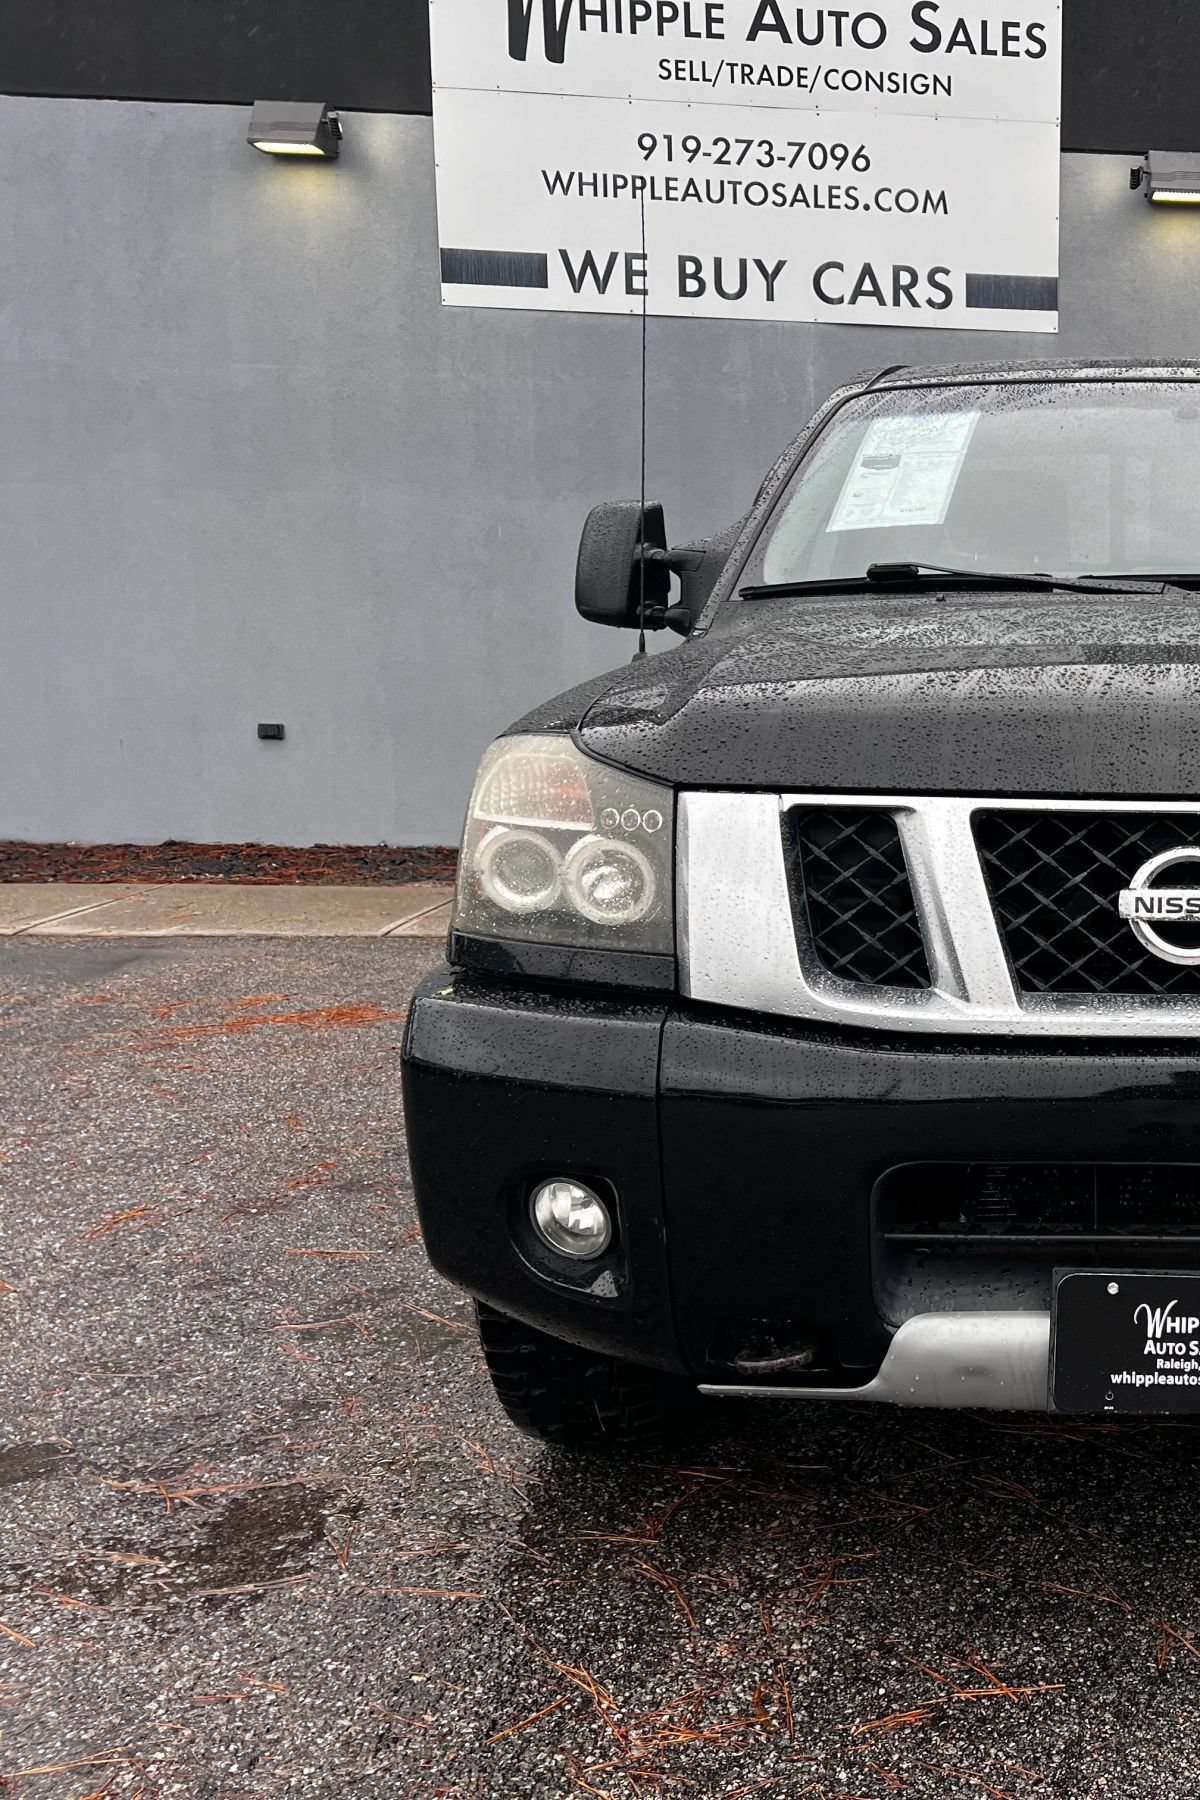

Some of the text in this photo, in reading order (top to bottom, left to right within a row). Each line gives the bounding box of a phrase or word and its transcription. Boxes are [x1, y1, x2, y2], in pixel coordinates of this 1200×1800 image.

[745, 0, 887, 50] AUTO
[909, 0, 1047, 60] SALES
[658, 58, 952, 97] SELL/TRADE/CONSIGN
[637, 132, 871, 173] 919-273-7096
[541, 169, 949, 215] WHIPPLEAUTOSALES.COM
[559, 248, 953, 310] WE BUY CARS
[1143, 1339, 1187, 1356] AUTO
